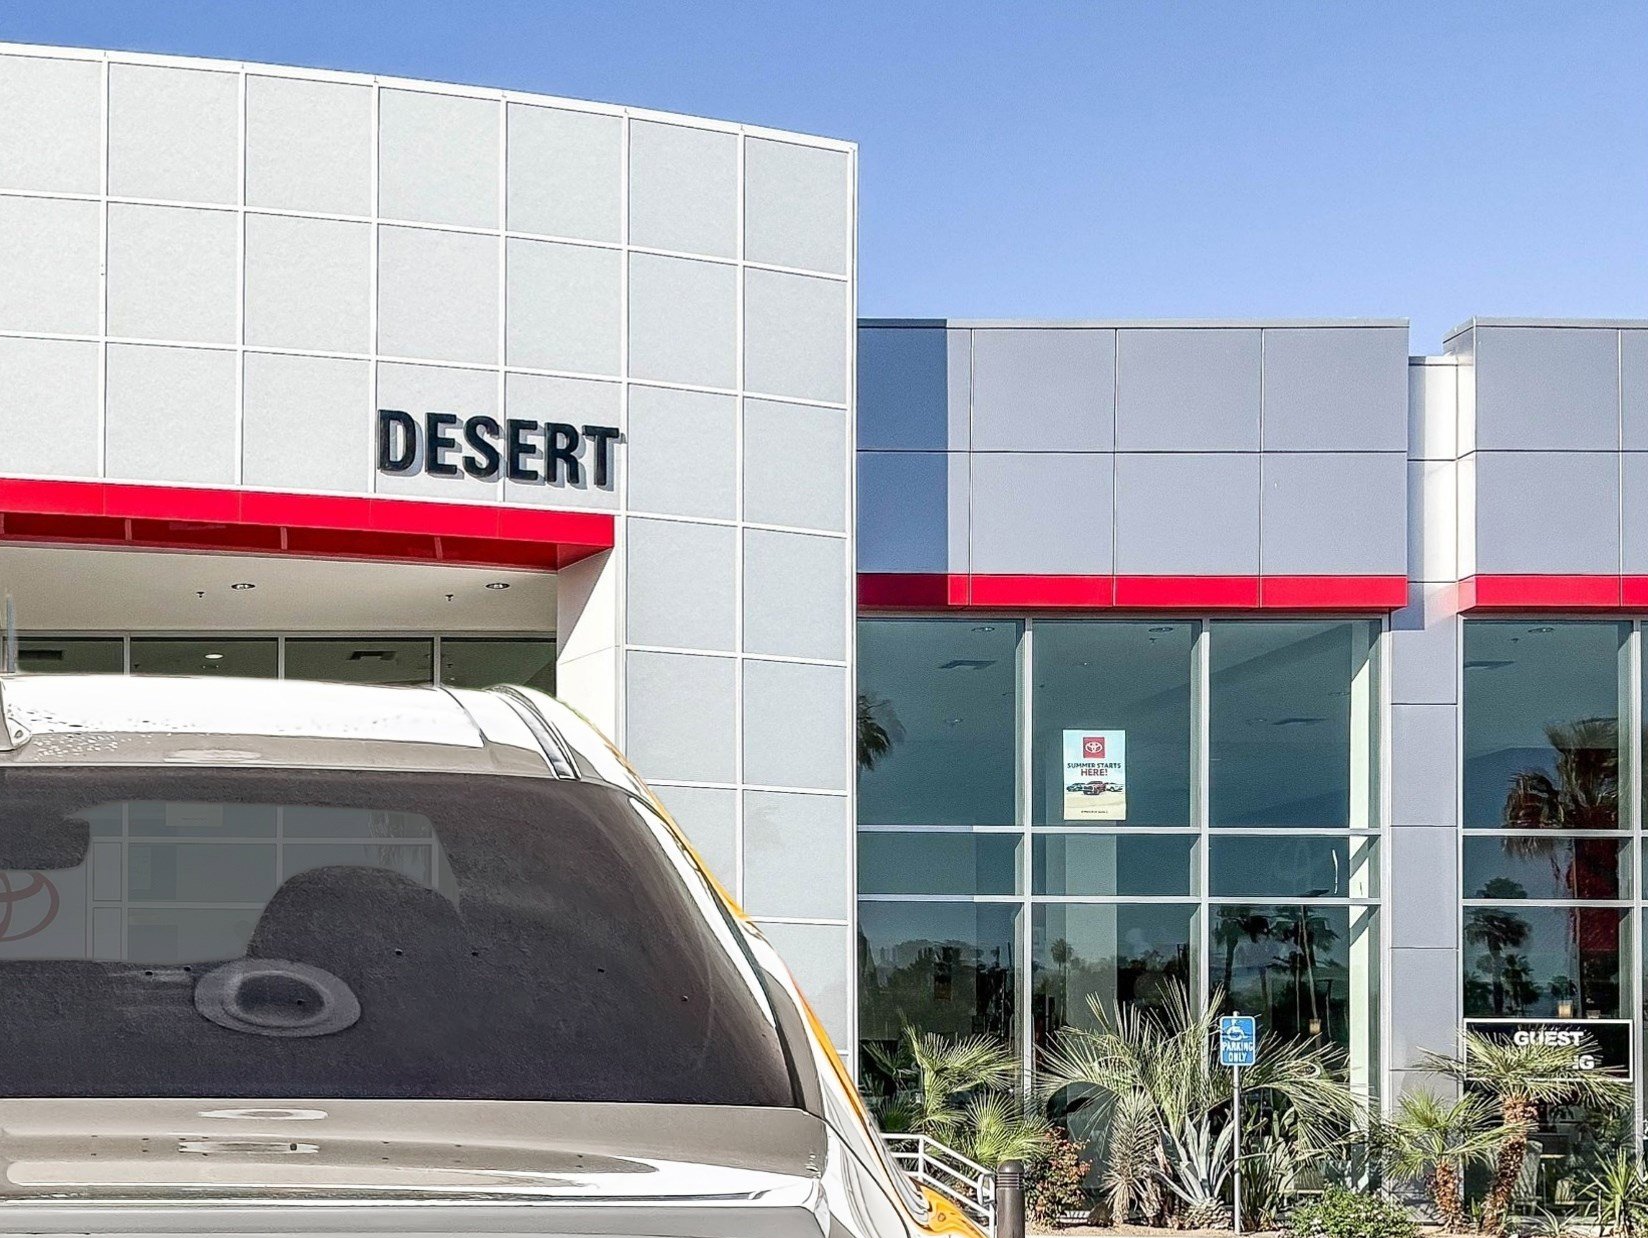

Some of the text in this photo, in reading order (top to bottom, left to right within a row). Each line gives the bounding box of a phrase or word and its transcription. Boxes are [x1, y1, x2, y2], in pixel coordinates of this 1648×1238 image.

[377, 409, 620, 486] DESERT
[1513, 1030, 1584, 1046] GUEST
[1222, 1041, 1253, 1051] PARKING
[1228, 1052, 1248, 1062] ONLY
